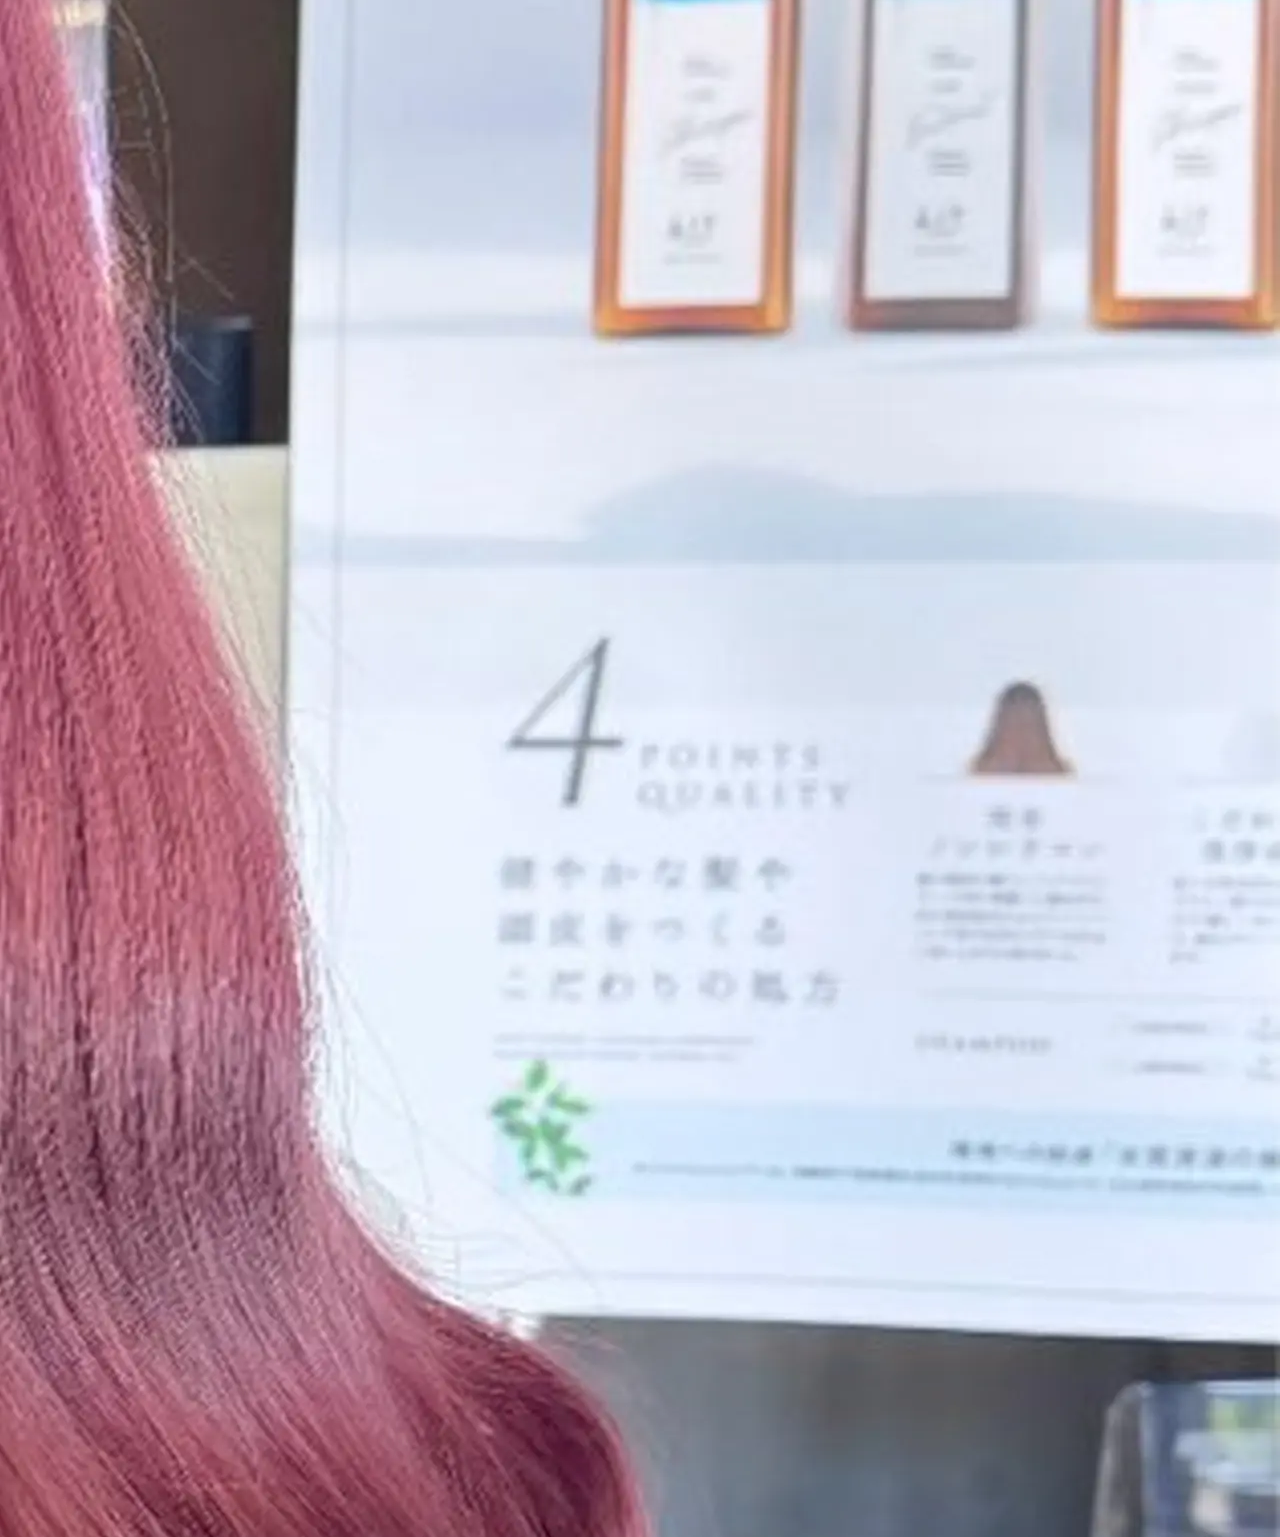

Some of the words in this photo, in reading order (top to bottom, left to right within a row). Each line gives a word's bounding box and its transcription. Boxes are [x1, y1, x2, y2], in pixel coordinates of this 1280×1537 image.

[506, 636, 624, 808] 4
[640, 742, 820, 771] POINTS
[636, 779, 850, 815] QUALITY
